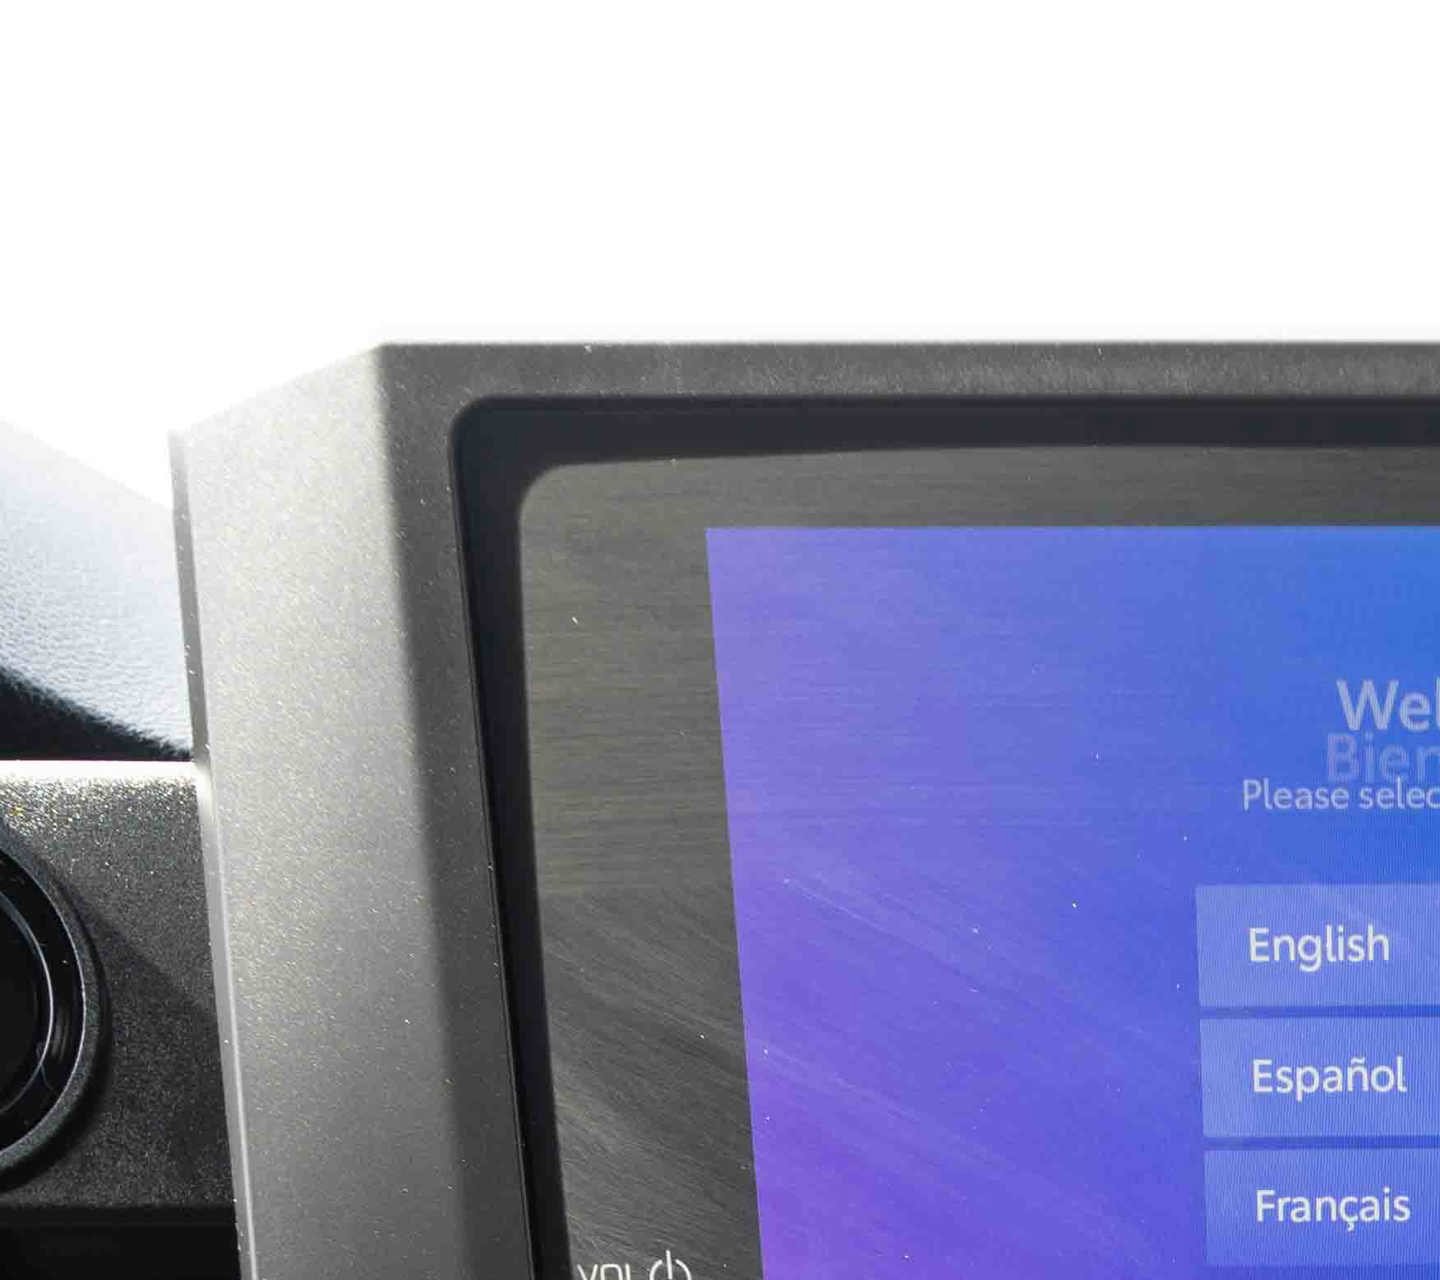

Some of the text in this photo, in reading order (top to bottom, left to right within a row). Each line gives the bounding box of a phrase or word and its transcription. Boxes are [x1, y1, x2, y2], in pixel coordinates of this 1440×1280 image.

[1242, 778, 1350, 810] Please
[1247, 926, 1391, 972] English
[1251, 1056, 1408, 1102] Español
[1254, 1187, 1412, 1232] Français
